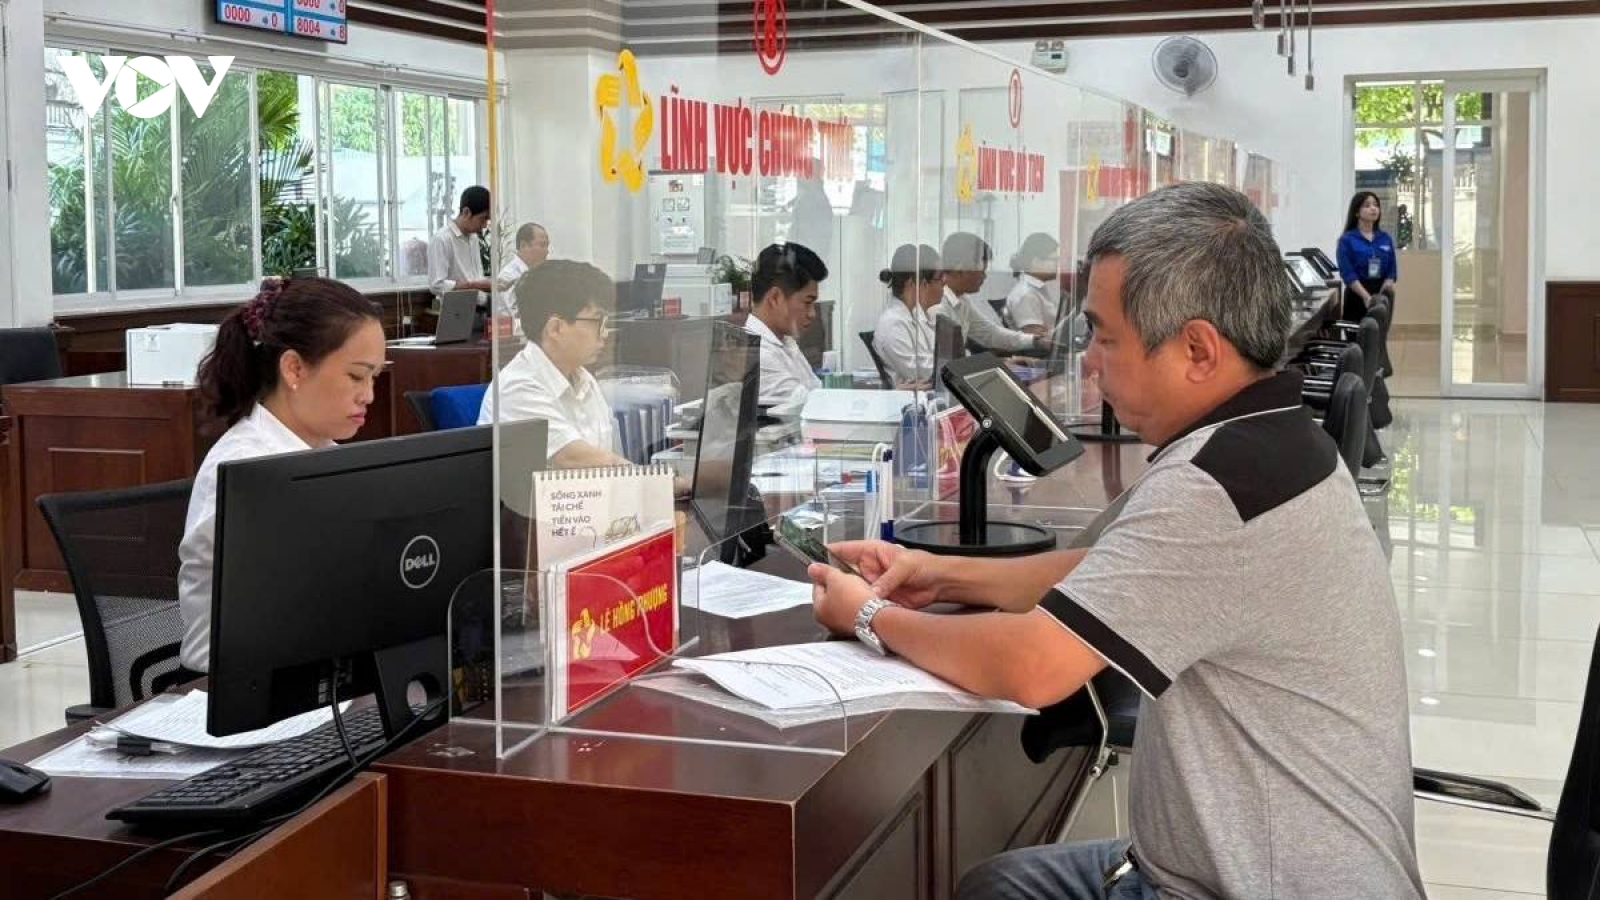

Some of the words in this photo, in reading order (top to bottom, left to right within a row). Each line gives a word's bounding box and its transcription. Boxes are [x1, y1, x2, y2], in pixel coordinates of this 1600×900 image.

[661, 85, 708, 173] LĨNH
[714, 97, 752, 190] VỰC
[405, 553, 436, 572] DELL
